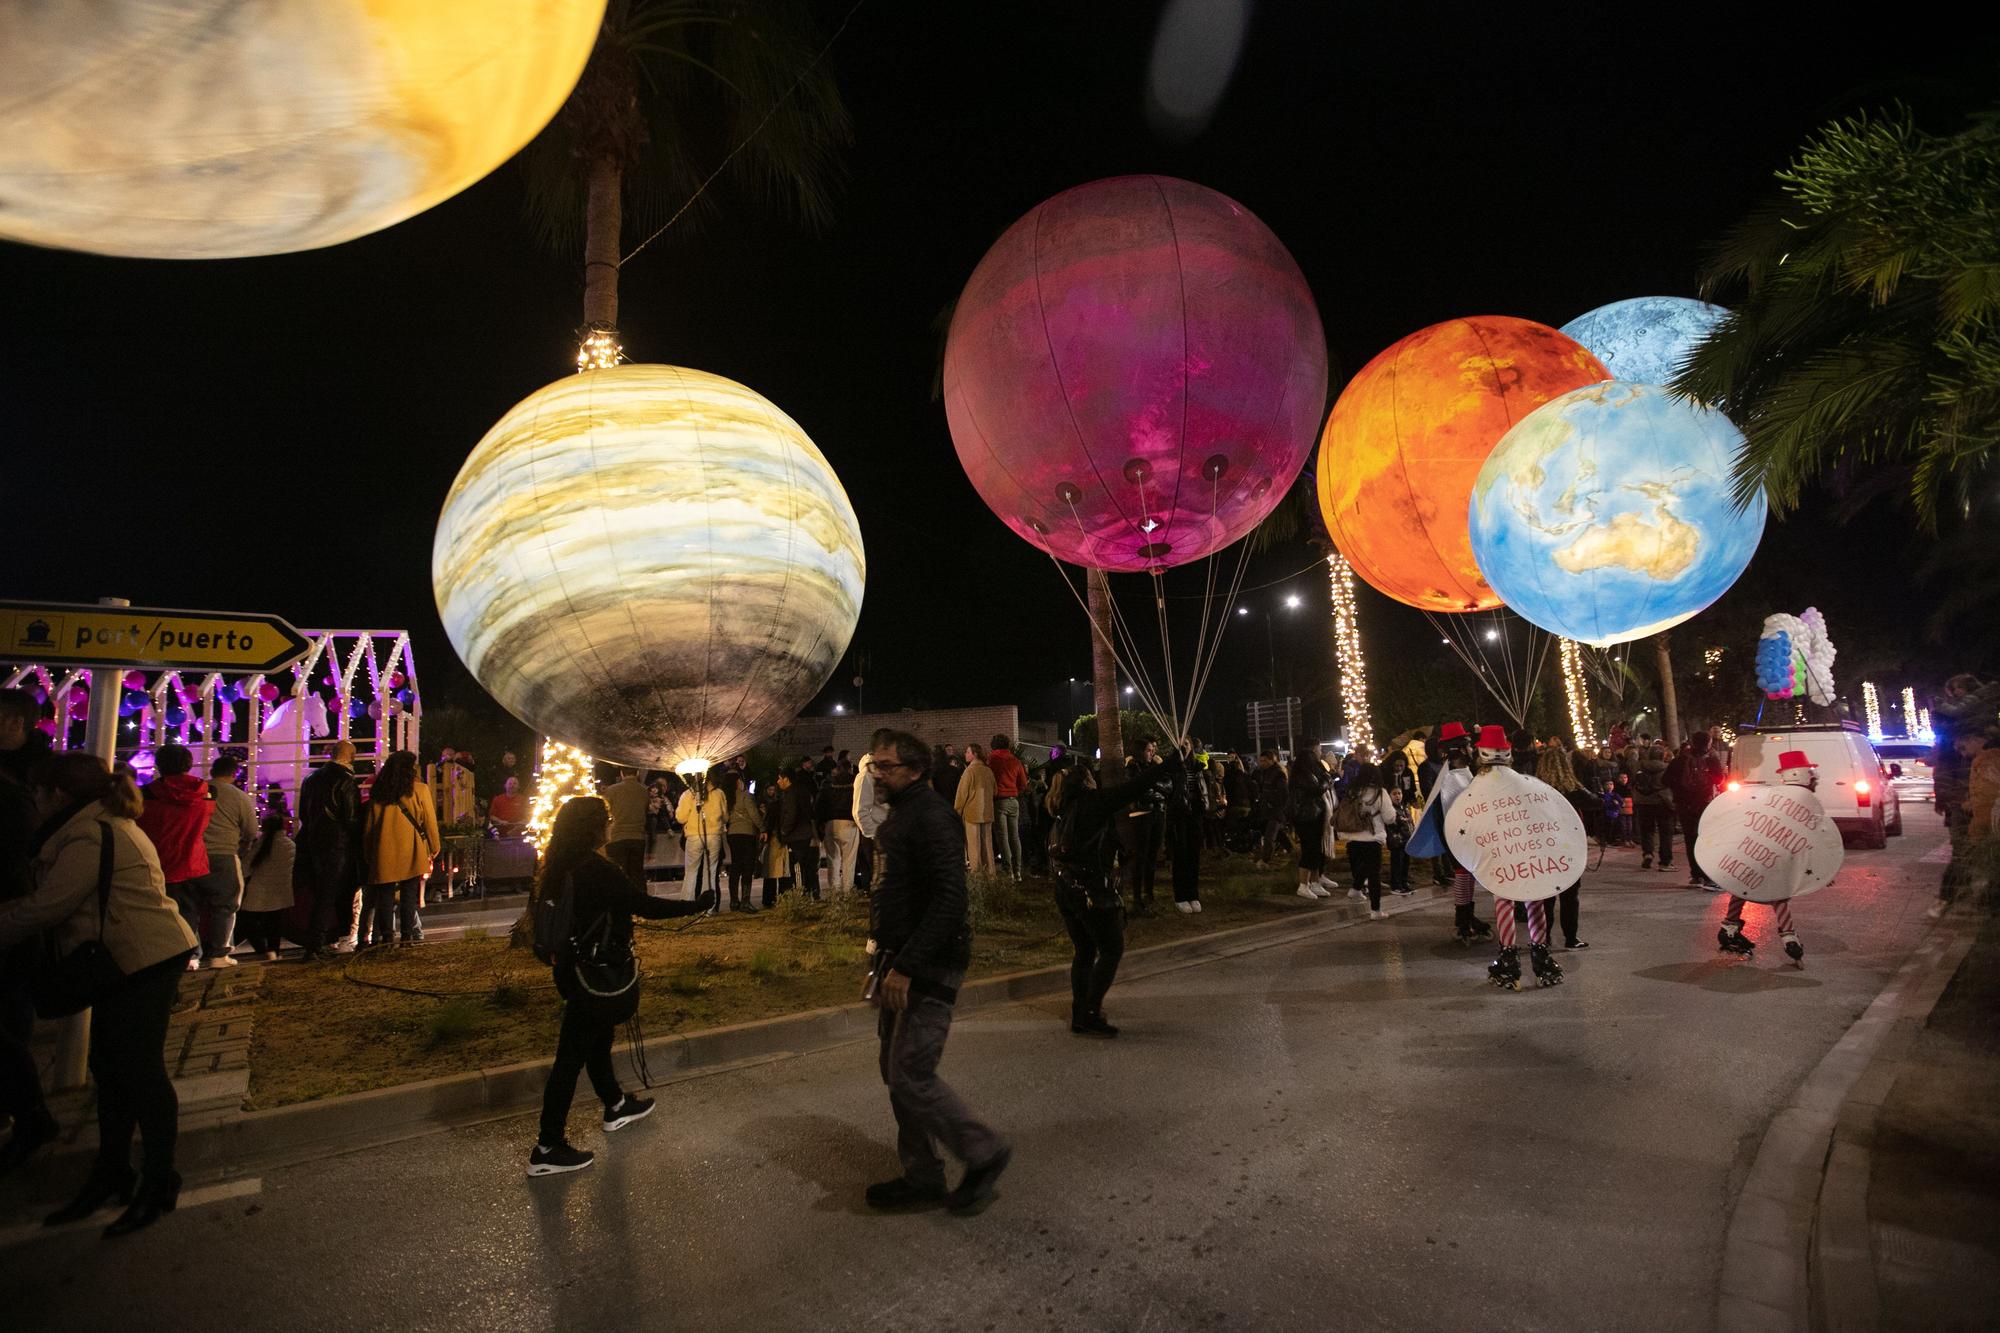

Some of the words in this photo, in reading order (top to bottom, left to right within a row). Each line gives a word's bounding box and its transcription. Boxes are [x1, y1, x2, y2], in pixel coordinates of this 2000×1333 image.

[1464, 802, 1488, 818] QUE
[1492, 795, 1521, 810] SEAS
[1526, 792, 1549, 804] TAN
[1496, 809, 1530, 825] FELIZ
[1778, 798, 1820, 831] PUEDES
[1475, 830, 1499, 847] QUE
[1503, 827, 1522, 840] NO
[1526, 821, 1560, 835] SEPAS
[1491, 847, 1501, 858] SI
[1505, 838, 1542, 855] VIVES
[1546, 837, 1556, 847] O
[1737, 836, 1781, 869] PUEDES
[1718, 854, 1765, 890] HACERLO
